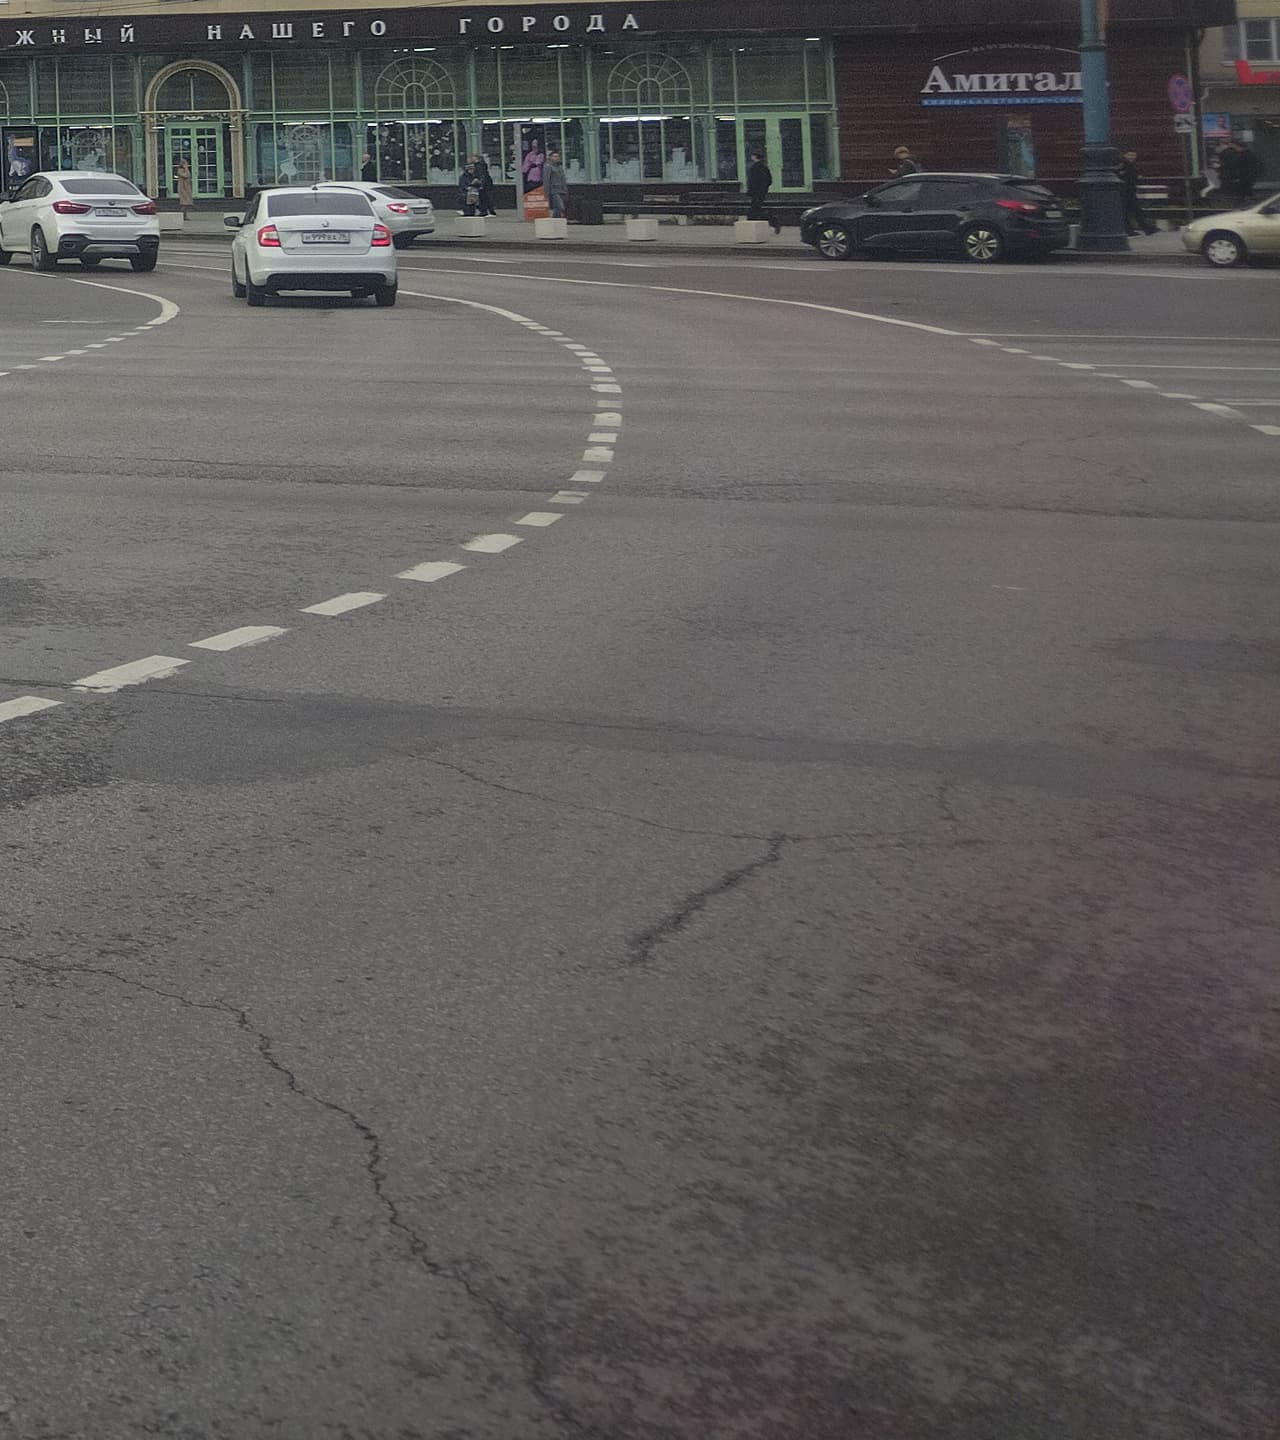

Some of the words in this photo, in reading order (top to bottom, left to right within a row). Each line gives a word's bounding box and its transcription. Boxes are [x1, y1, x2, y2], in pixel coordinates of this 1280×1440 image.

[206, 19, 387, 41] НАШЕГО
[458, 13, 640, 35] ГОРОДА
[919, 64, 1083, 93] Амитал
